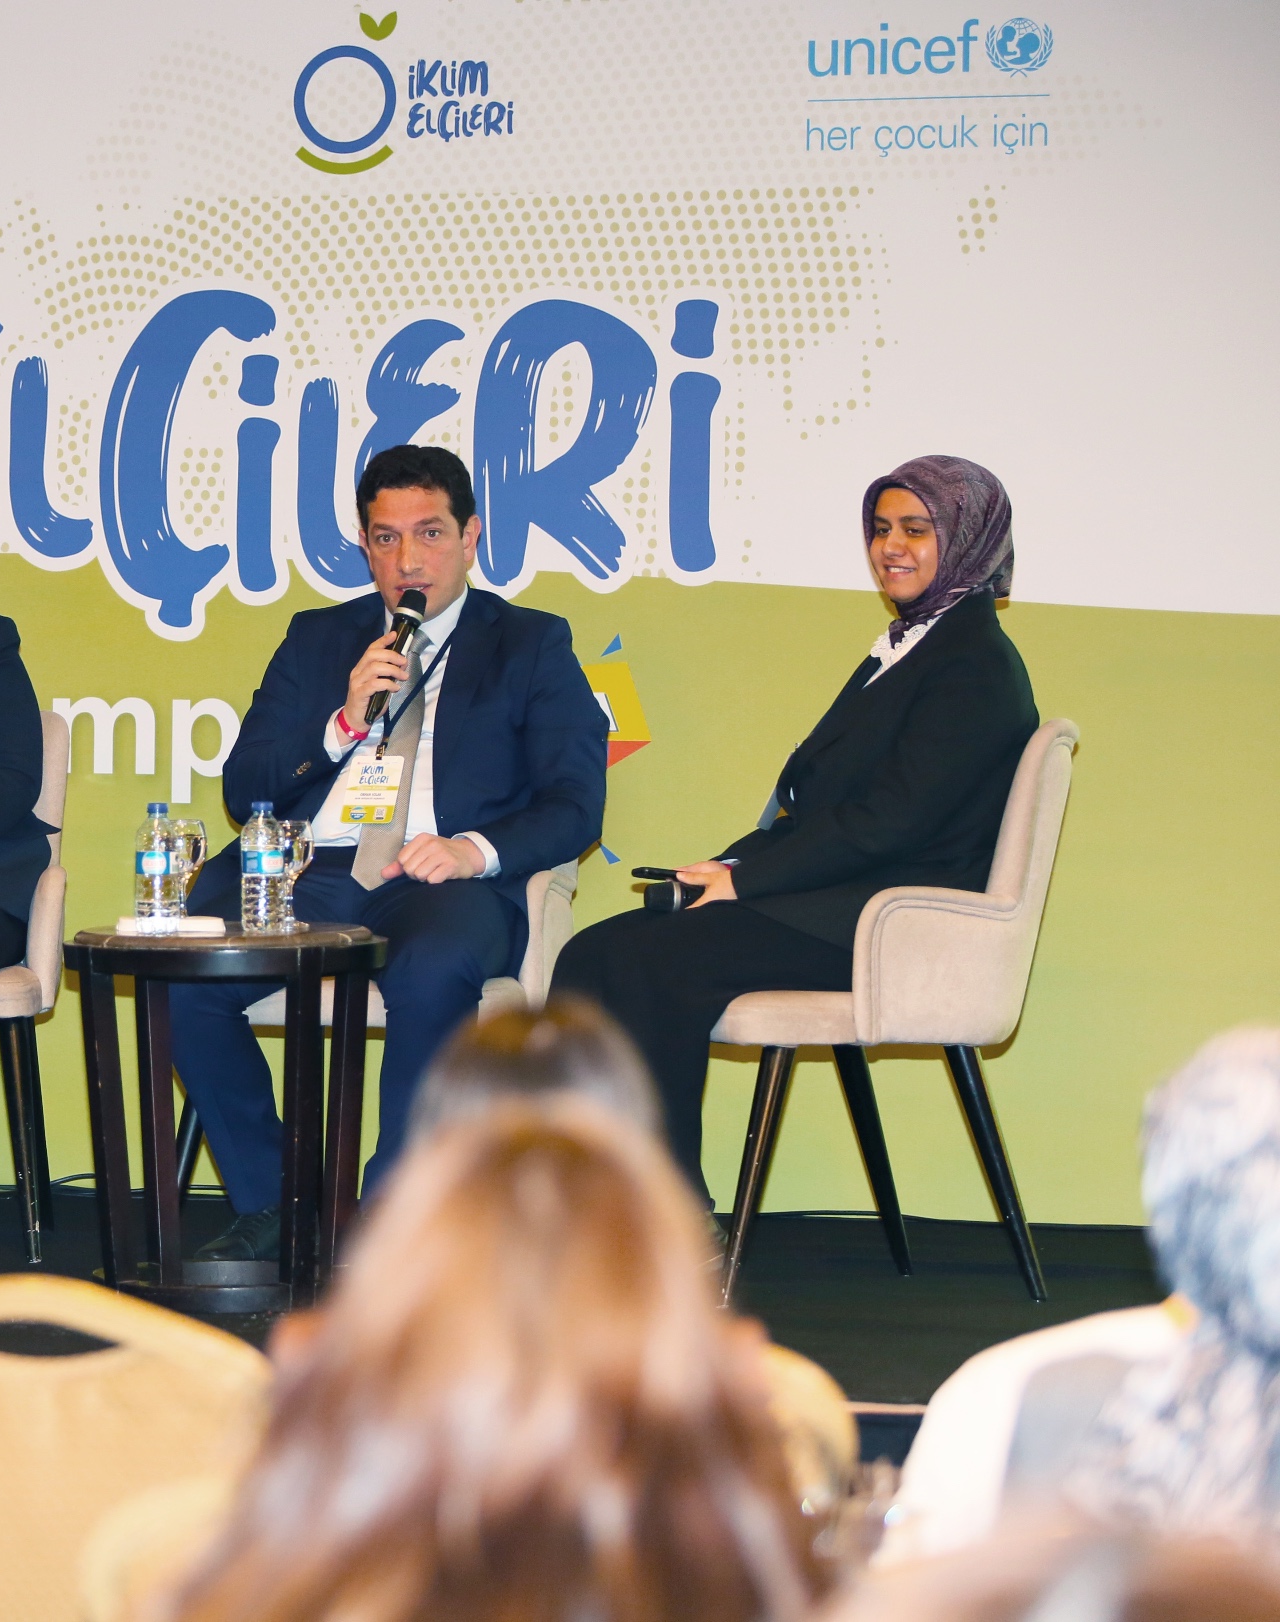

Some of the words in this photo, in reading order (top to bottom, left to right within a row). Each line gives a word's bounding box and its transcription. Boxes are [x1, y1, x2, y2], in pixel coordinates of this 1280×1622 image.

[807, 18, 979, 77] unicef
[806, 118, 862, 151] her
[874, 115, 978, 157] çocuk
[993, 113, 1048, 154] için
